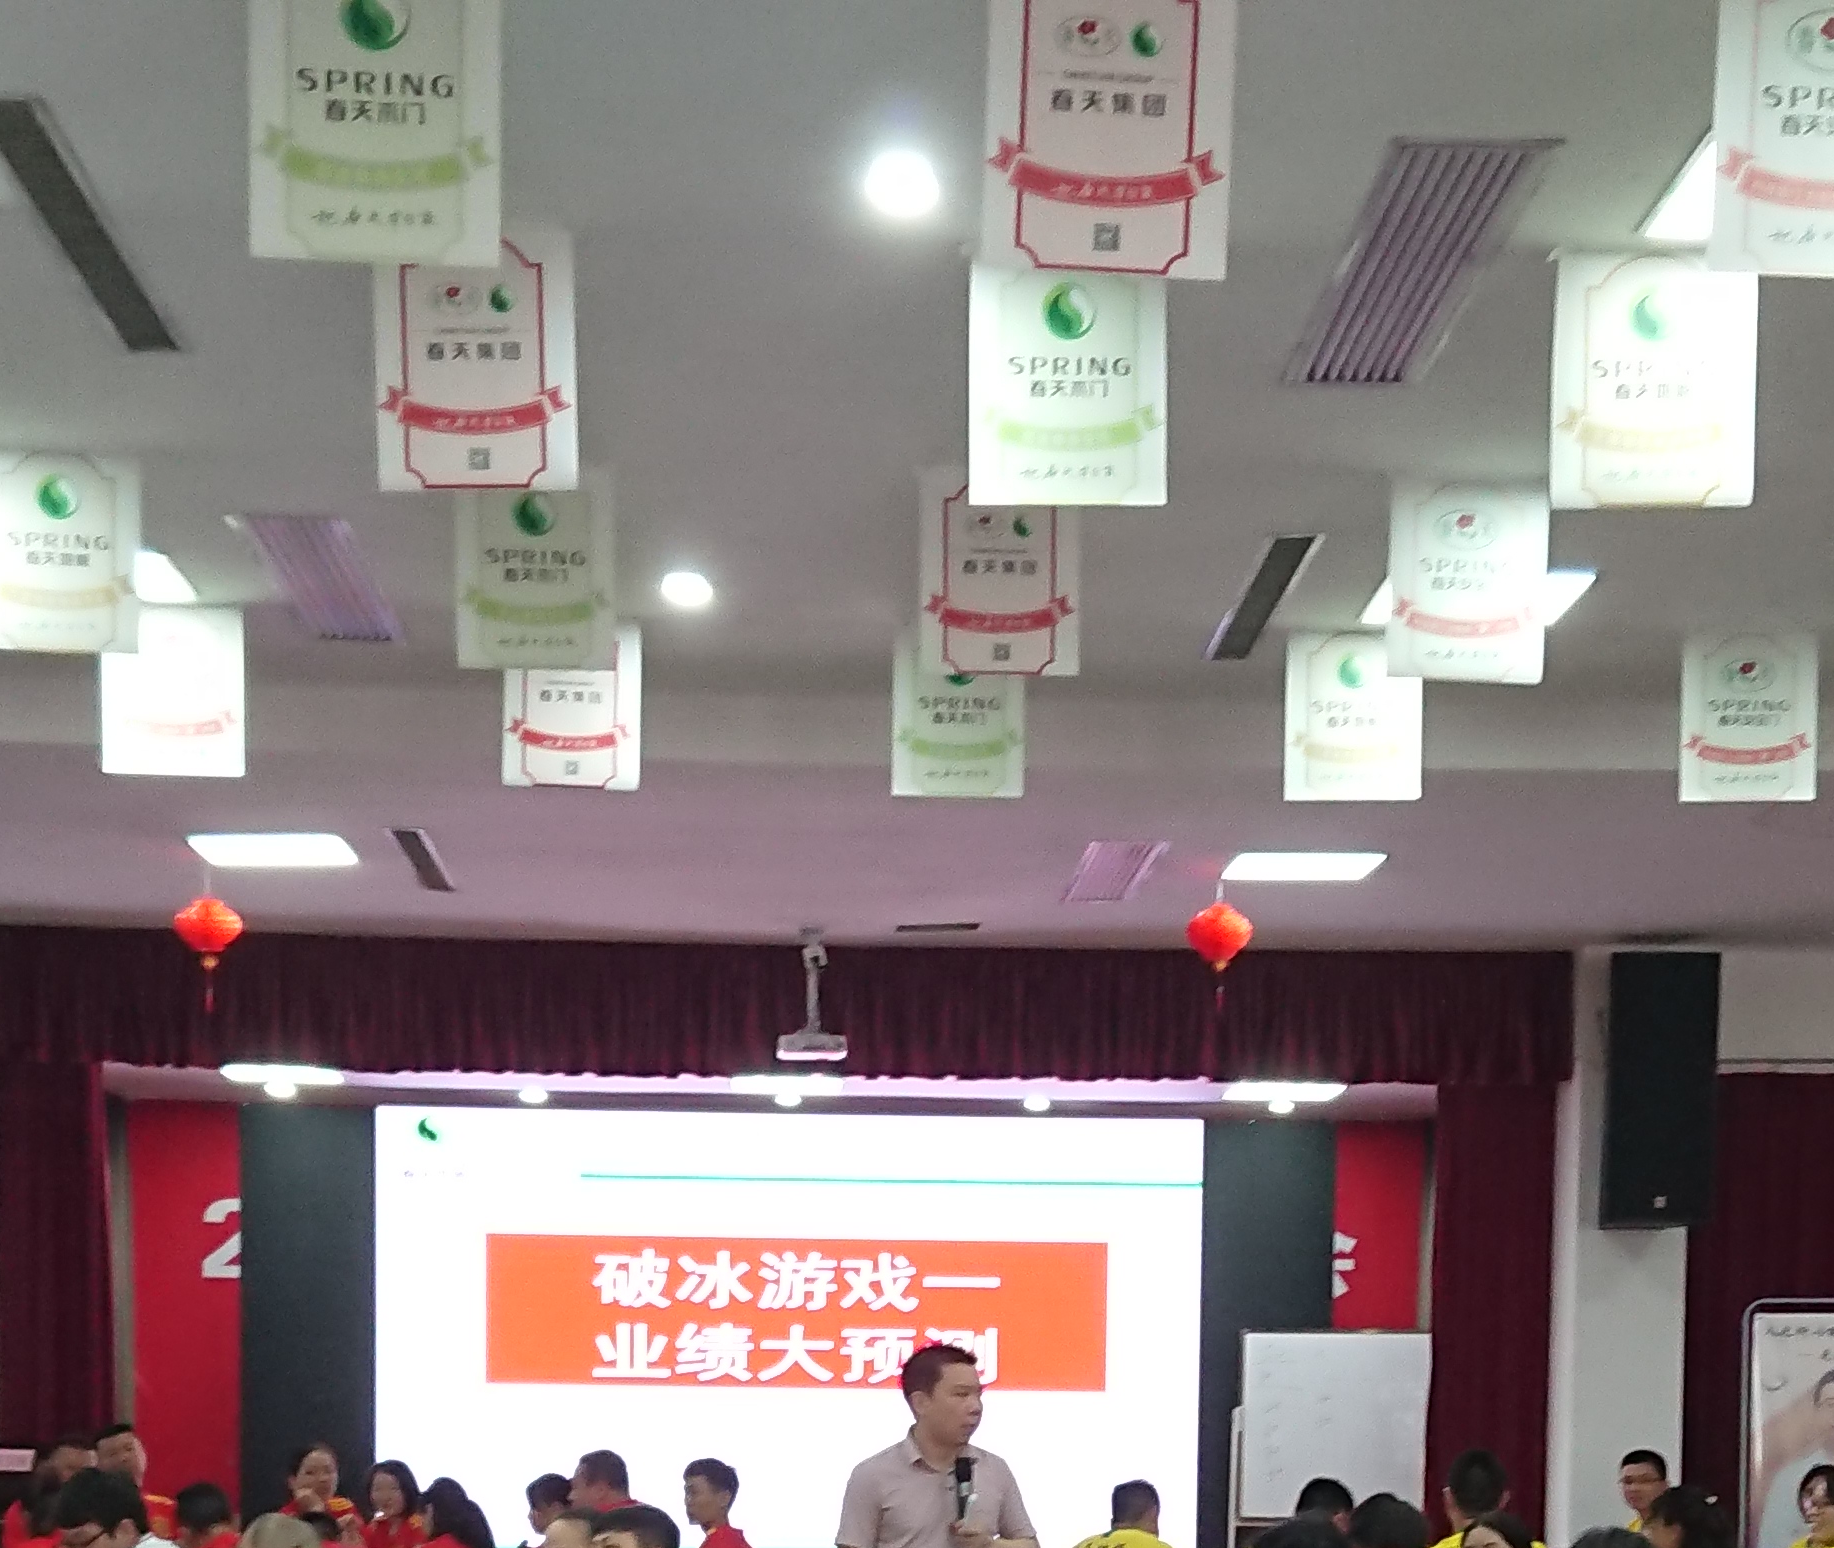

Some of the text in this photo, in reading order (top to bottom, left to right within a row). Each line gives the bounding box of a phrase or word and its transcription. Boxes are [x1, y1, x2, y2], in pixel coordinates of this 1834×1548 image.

[296, 68, 456, 100] SPRING
[1008, 356, 1133, 378] SPRING
[7, 531, 110, 551] SPRING
[484, 546, 586, 566] SPRING
